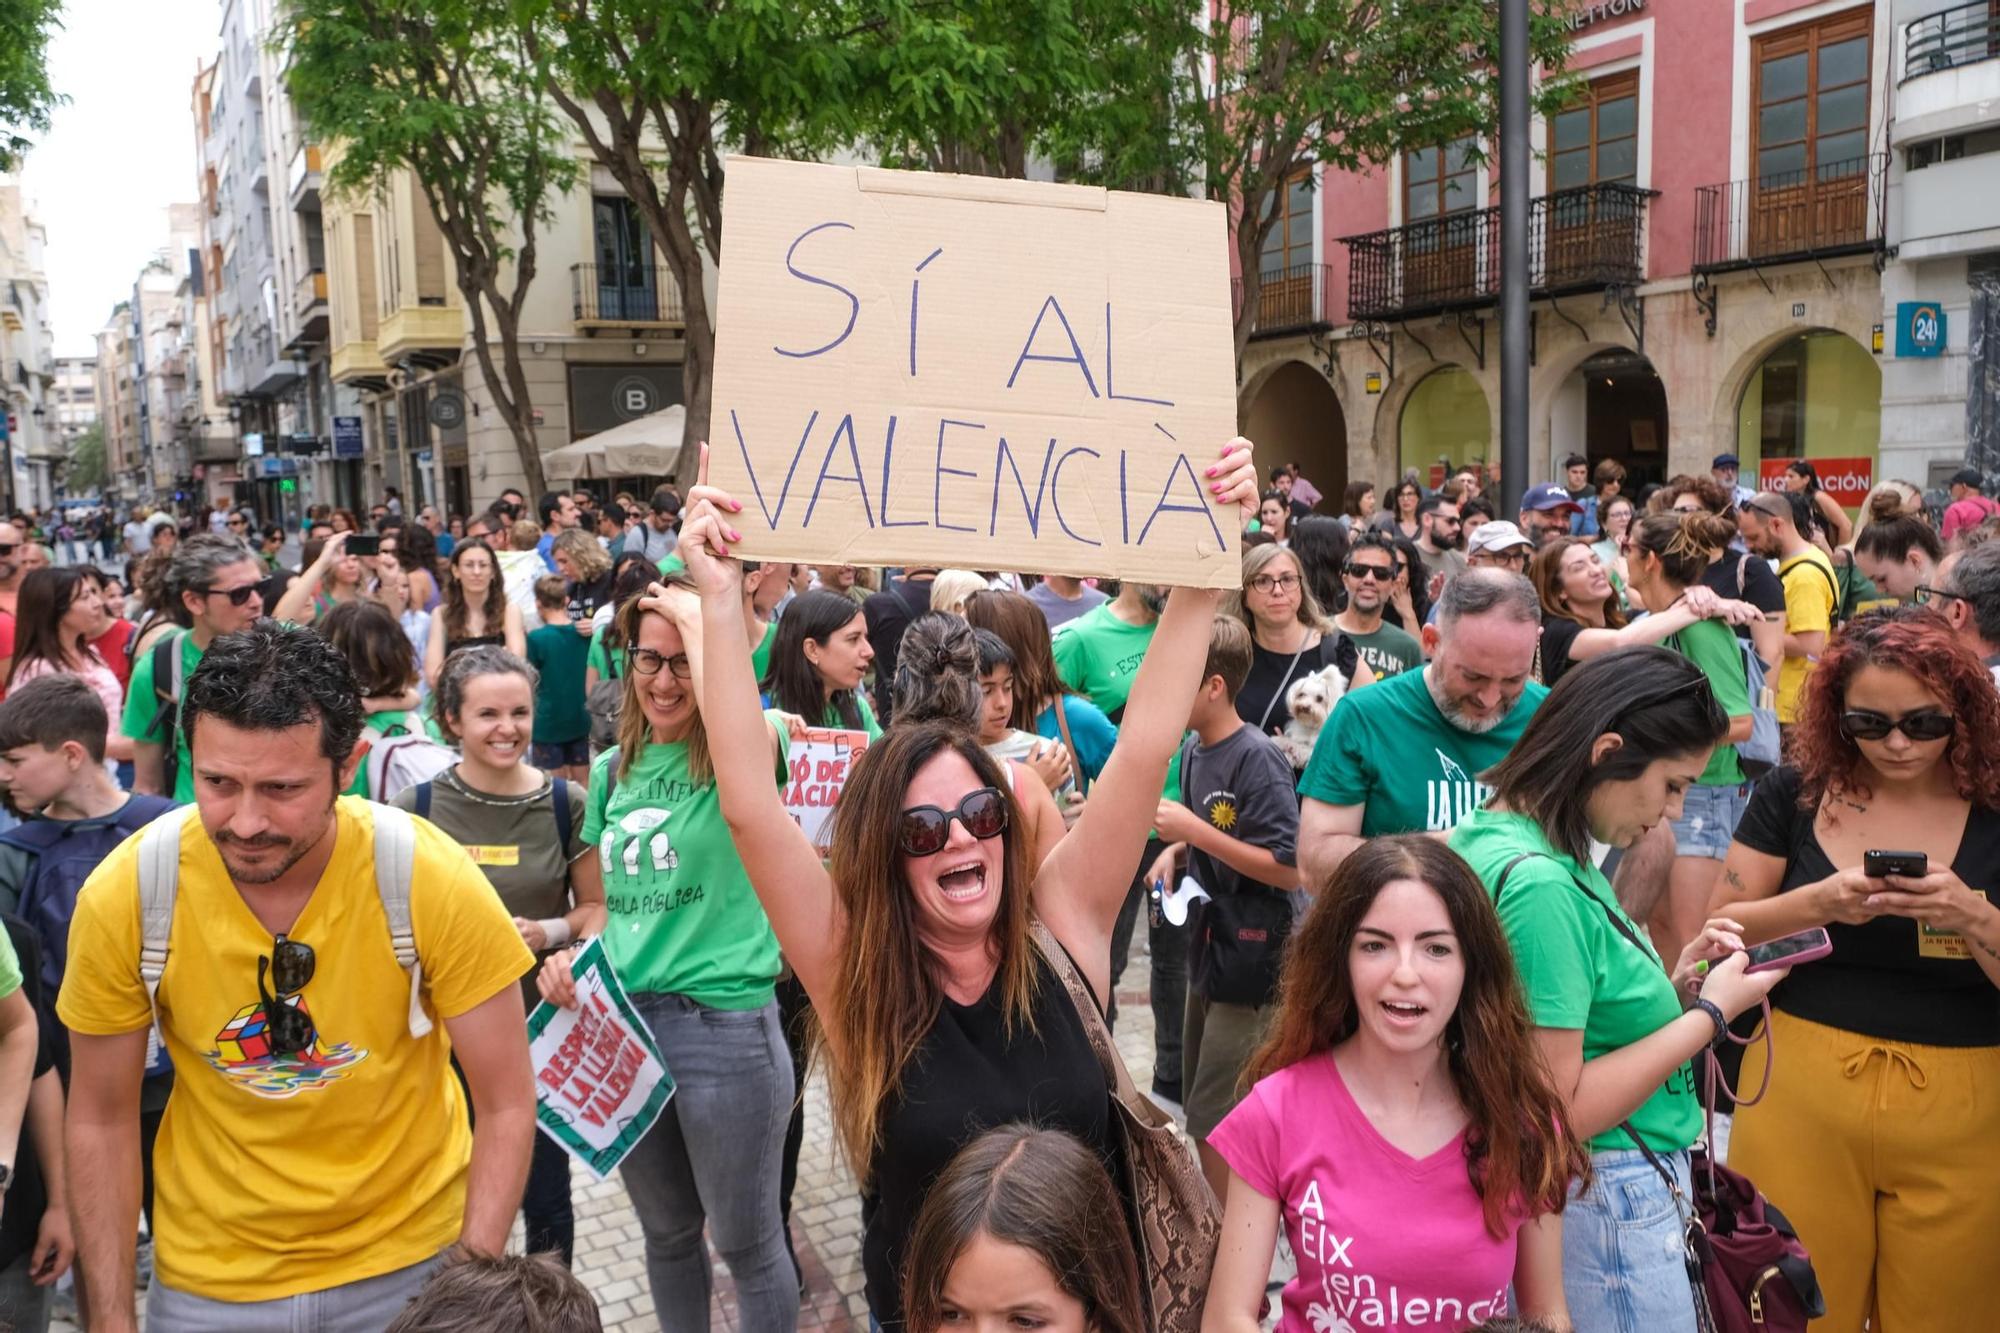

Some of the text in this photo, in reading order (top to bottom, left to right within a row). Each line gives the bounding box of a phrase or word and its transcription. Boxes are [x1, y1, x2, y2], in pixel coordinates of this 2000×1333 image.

[773, 221, 1175, 407] SÍ AL
[626, 389, 646, 411] B
[730, 409, 1226, 553] VALENCIÀ
[816, 759, 846, 783] DE
[561, 1076, 596, 1109] LA
[1298, 1180, 1326, 1221] A
[1330, 1273, 1376, 1298] en
